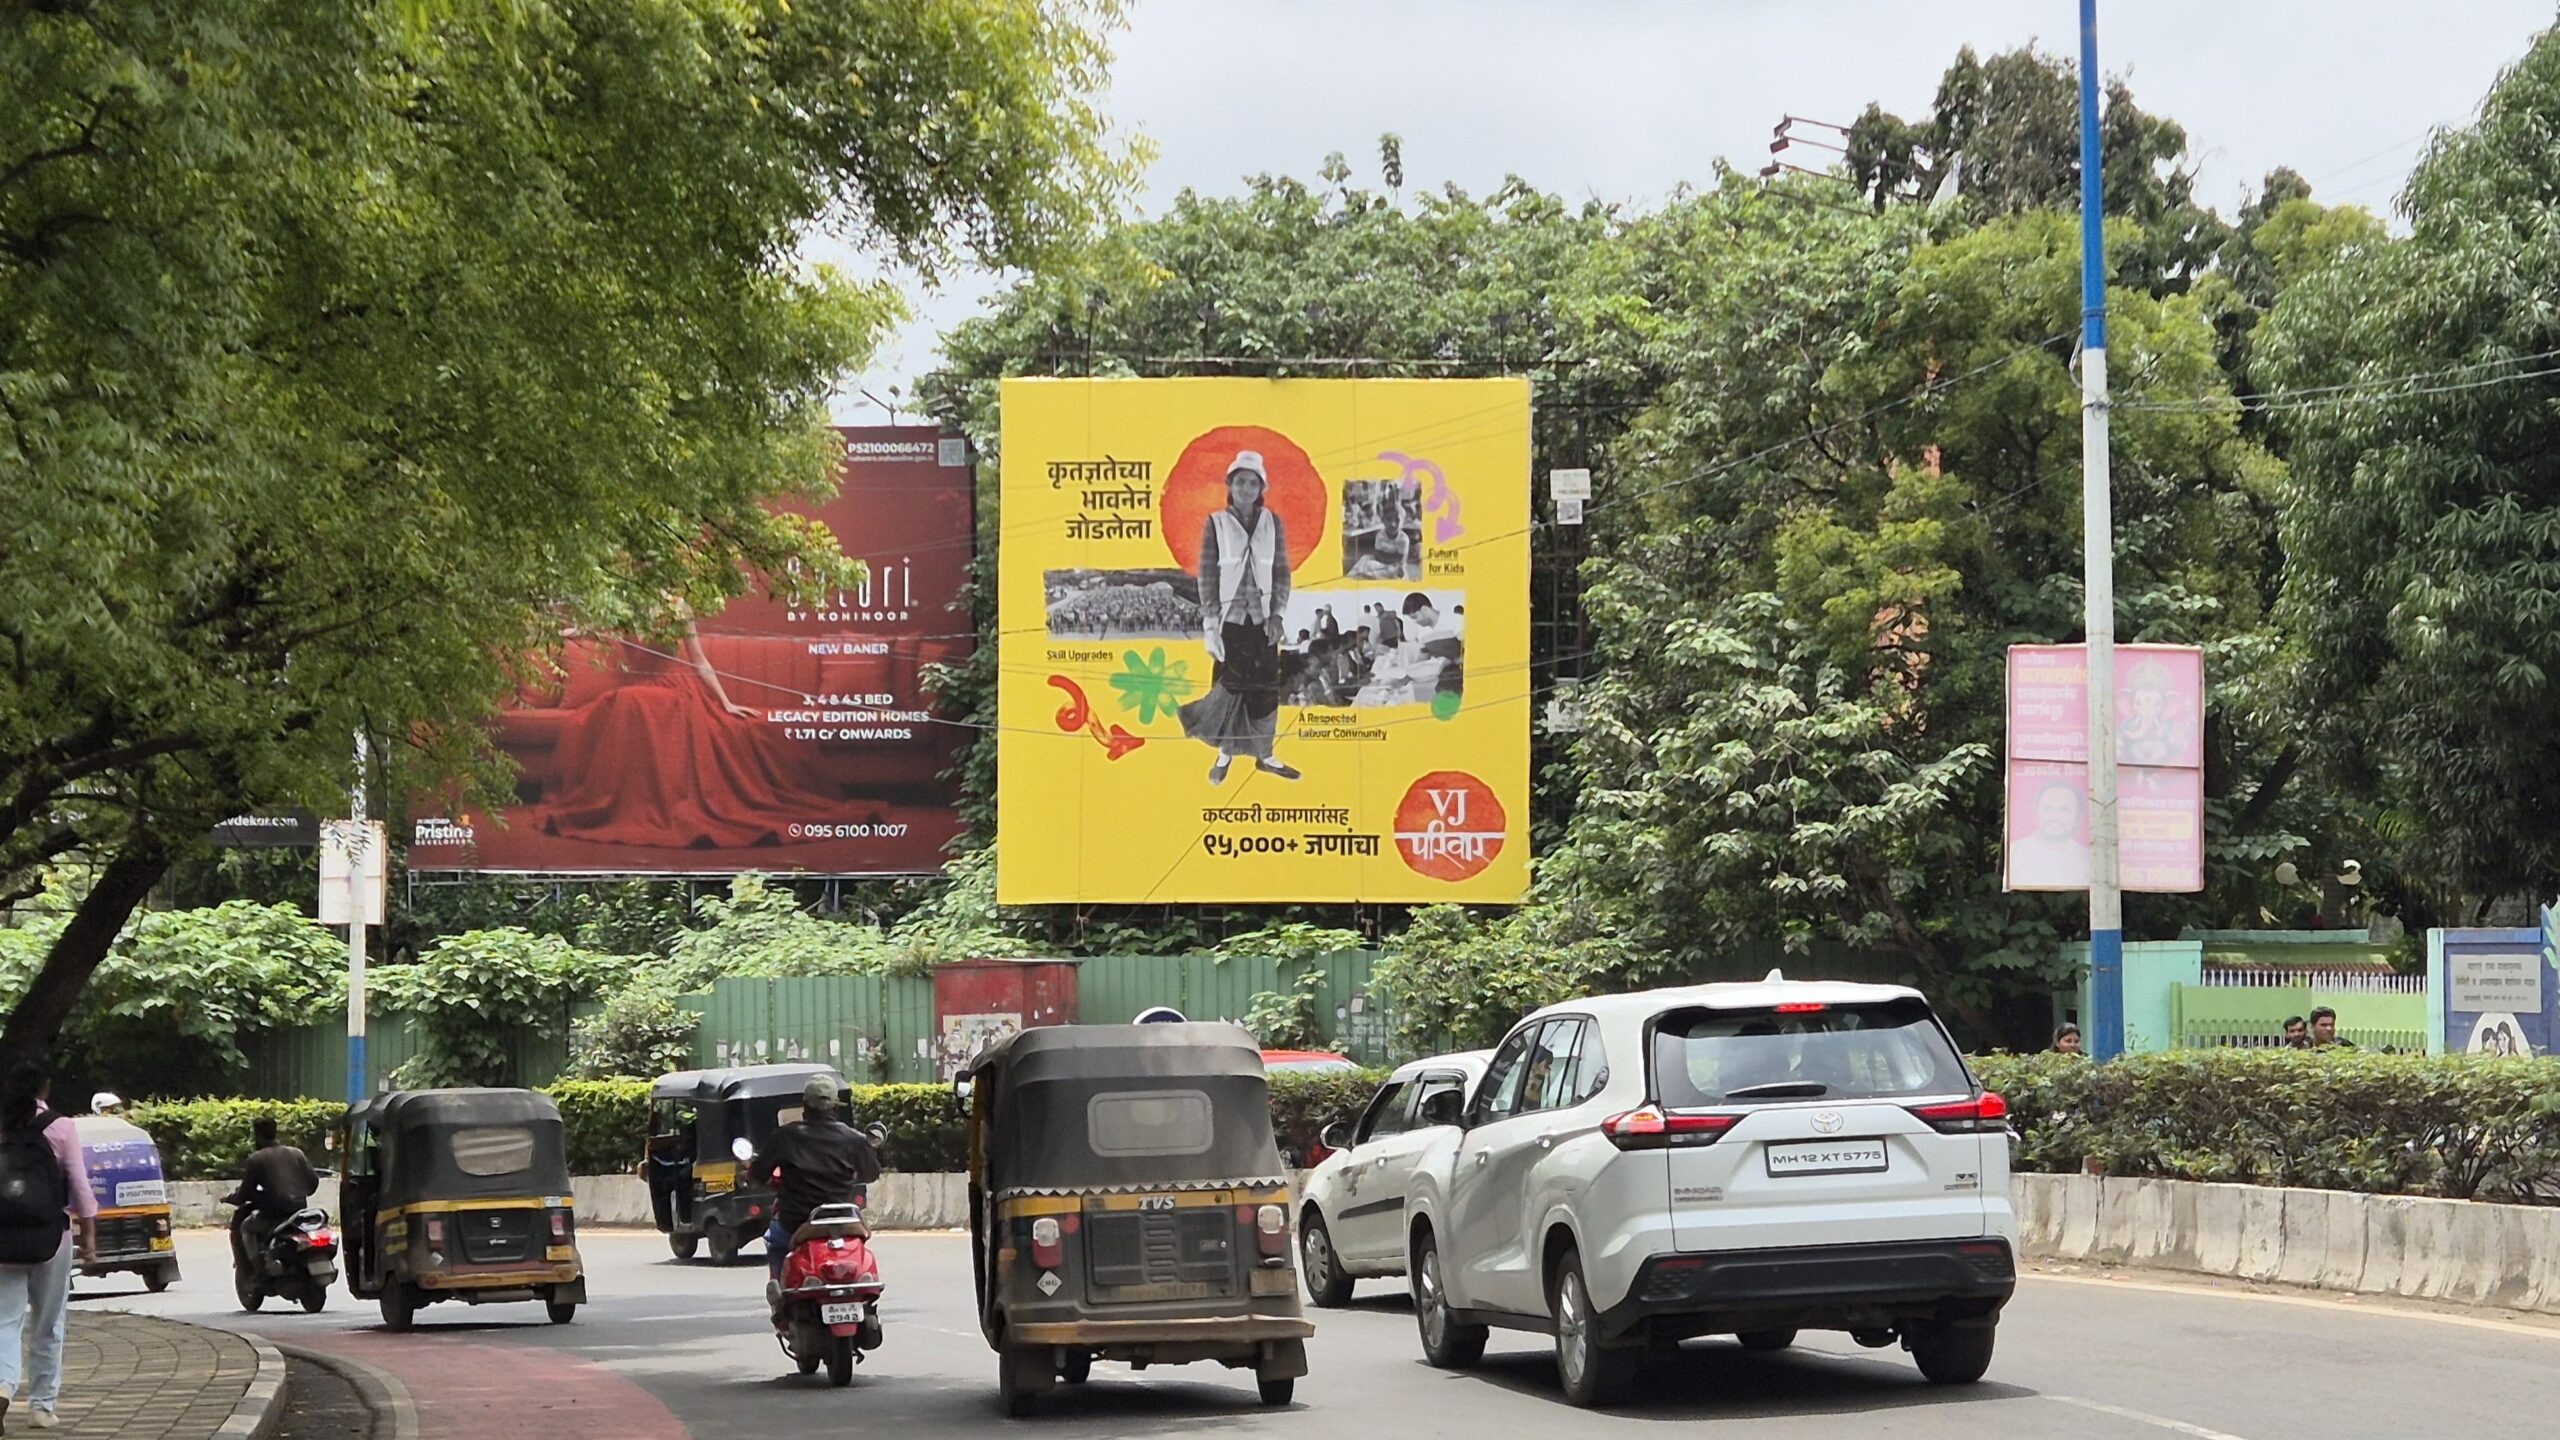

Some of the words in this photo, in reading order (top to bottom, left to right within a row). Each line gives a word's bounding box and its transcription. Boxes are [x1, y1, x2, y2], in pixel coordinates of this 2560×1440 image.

[1046, 454, 1152, 489] कृतज्ञतेच्या
[1081, 483, 1152, 510] भावनेनं
[1065, 513, 1152, 540] जोडलेला
[1429, 563, 1441, 573] for
[1444, 563, 1465, 573] Kids
[787, 611, 807, 621] BY
[817, 611, 908, 621] KOHINOOR
[808, 643, 840, 655] NEW
[843, 643, 889, 655] BANER
[1046, 650, 1067, 660] Skill
[1068, 650, 1113, 662] Upgrades
[817, 694, 827, 705] 4
[864, 694, 893, 705] BED
[767, 711, 820, 722] LEGACY
[822, 711, 877, 722] EDITION
[881, 711, 929, 722] HOMES
[1299, 713, 1305, 723] A
[1307, 713, 1357, 725] Respected
[795, 729, 816, 740] 1.71
[840, 729, 912, 740] ONWARDS
[1333, 728, 1387, 740] Community
[1202, 803, 1262, 823] कष्टकरी
[1265, 804, 1349, 825] कामगारांसह
[1425, 789, 1468, 826] VJ
[416, 823, 474, 838] Pristine
[804, 824, 832, 837] 095
[835, 824, 870, 837] 6100
[873, 824, 907, 837] 1007
[1303, 827, 1380, 856] जणांचा
[1773, 1156, 1799, 1164] MH
[1801, 1154, 1818, 1163] 12
[1821, 1153, 1840, 1162] XT
[1843, 1151, 1882, 1161] 5775
[1139, 1196, 1175, 1210] TVS
